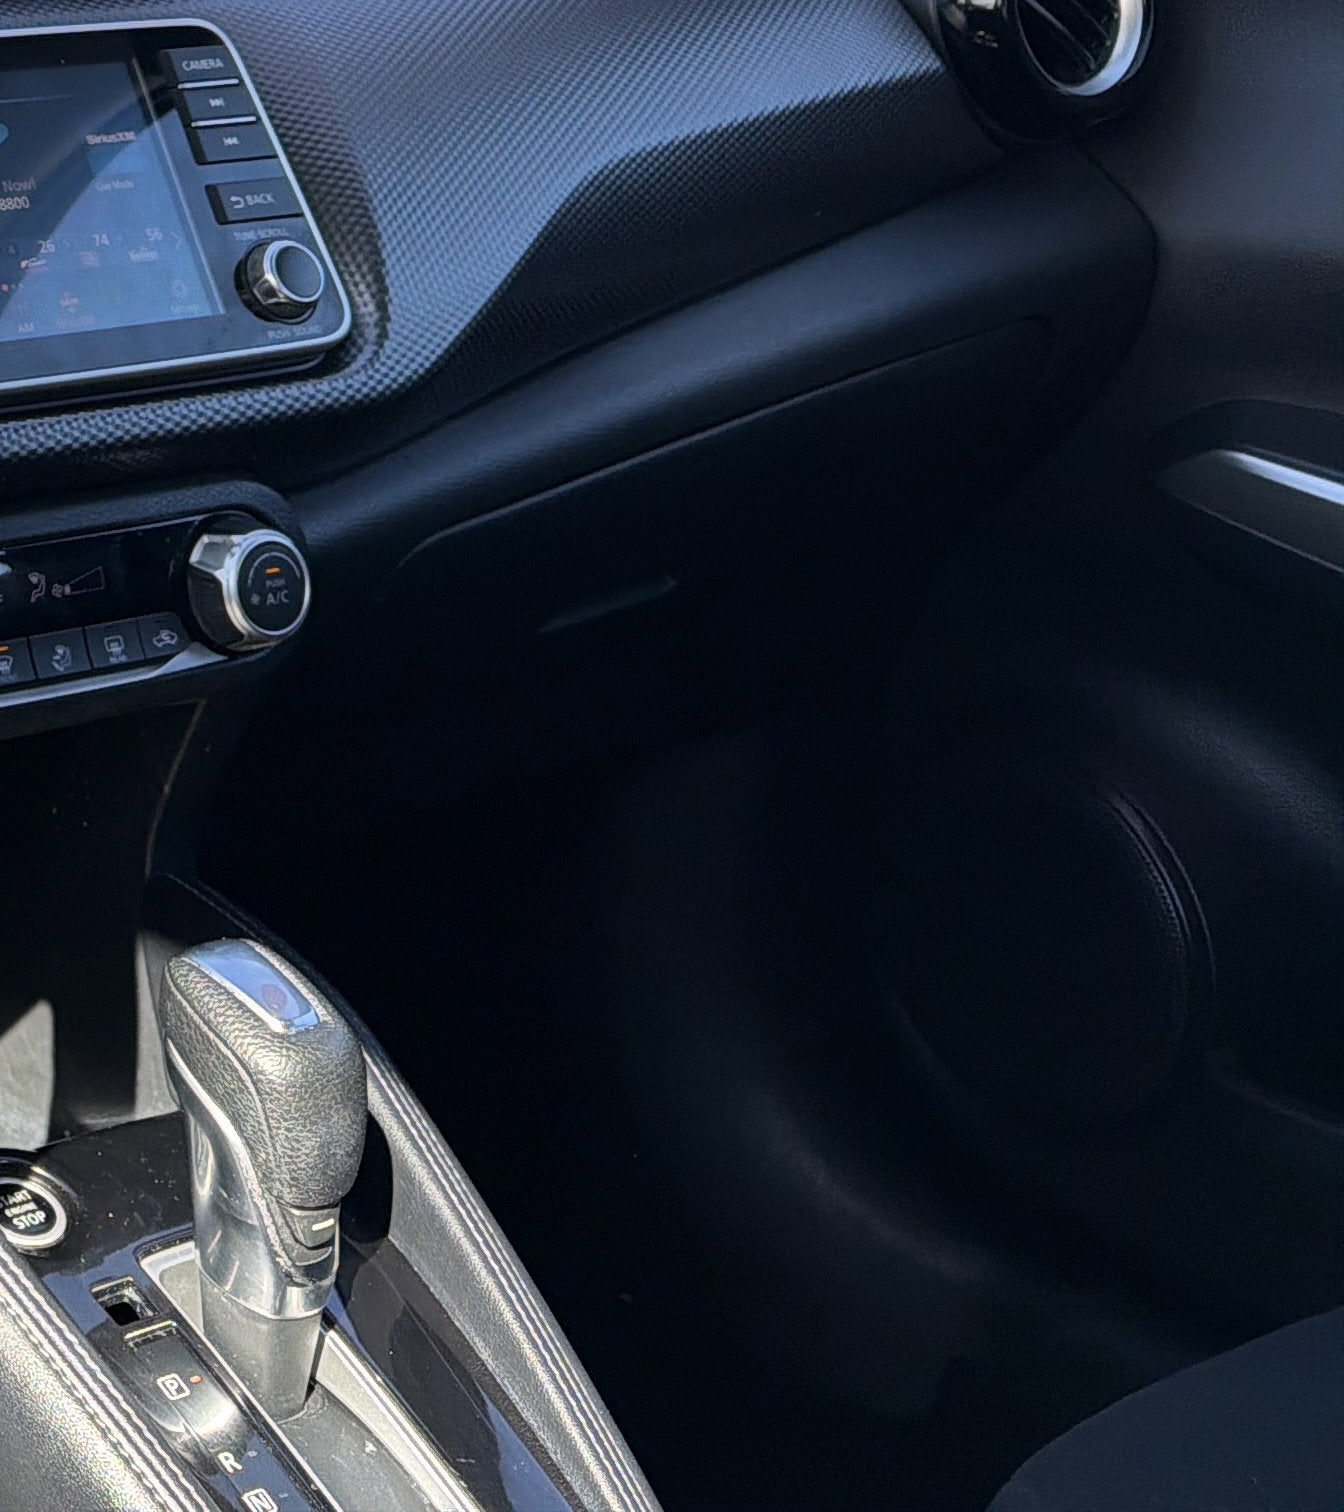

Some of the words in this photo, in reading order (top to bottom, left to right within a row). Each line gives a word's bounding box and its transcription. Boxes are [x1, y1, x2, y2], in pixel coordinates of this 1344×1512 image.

[181, 57, 225, 72] CAMERA
[244, 192, 276, 206] BACK
[39, 239, 56, 254] 26
[265, 590, 290, 606] A/C
[12, 1210, 47, 1230] STOP
[217, 1451, 243, 1475] R
